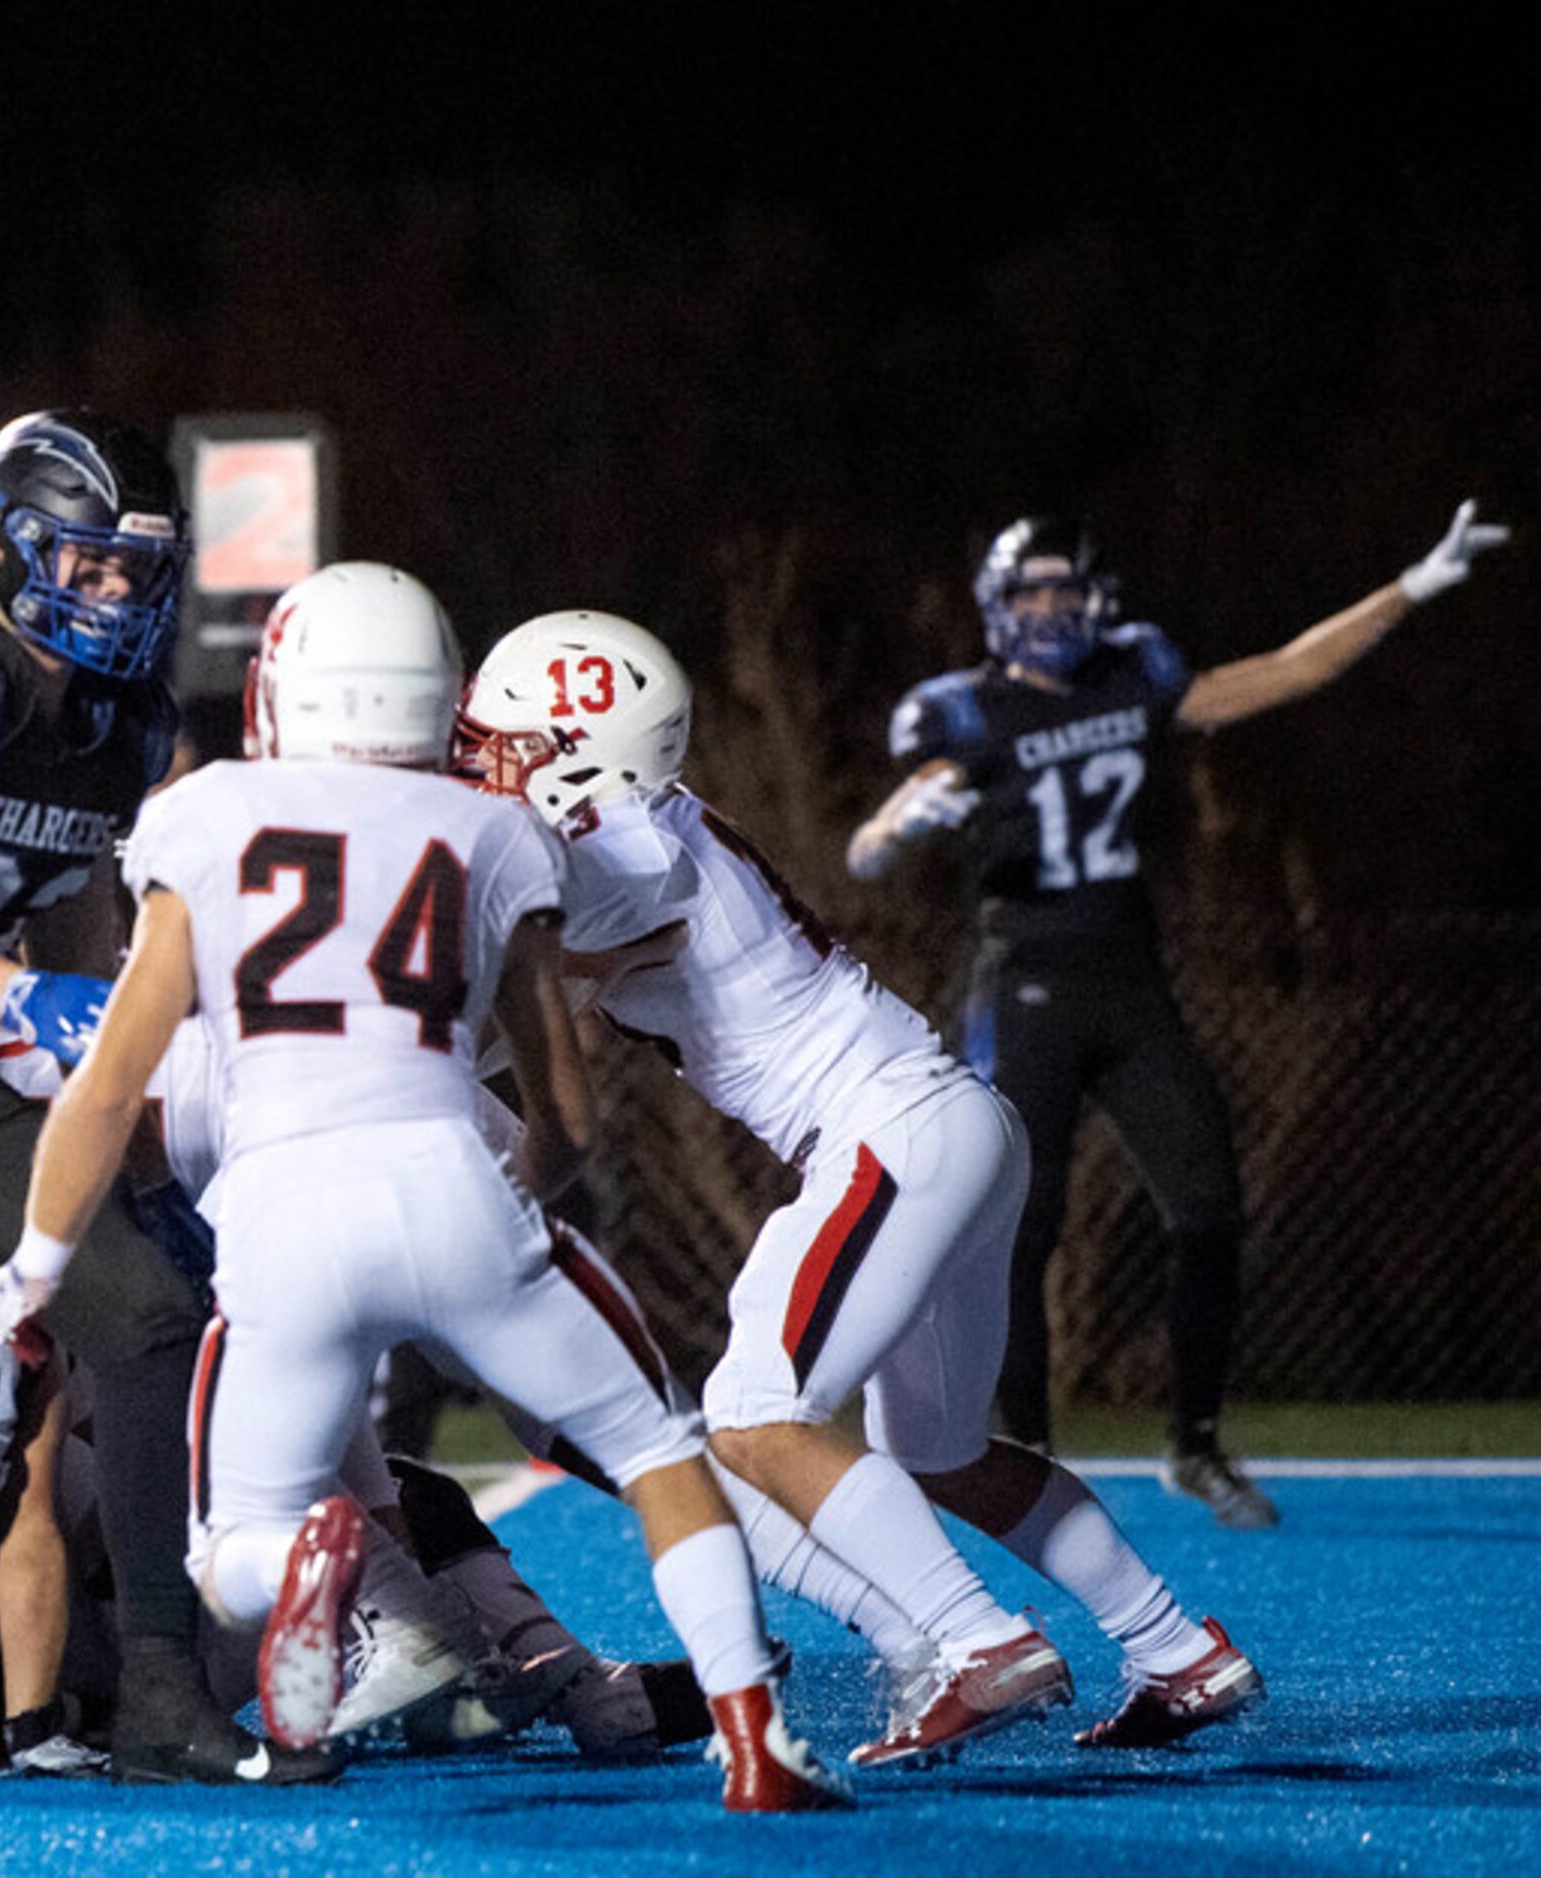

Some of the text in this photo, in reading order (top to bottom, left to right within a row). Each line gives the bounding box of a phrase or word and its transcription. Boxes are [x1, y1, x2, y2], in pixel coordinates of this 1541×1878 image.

[200, 444, 314, 587] 2
[547, 655, 614, 717] 13
[1028, 748, 1145, 888] 12
[233, 827, 468, 1055] 24
